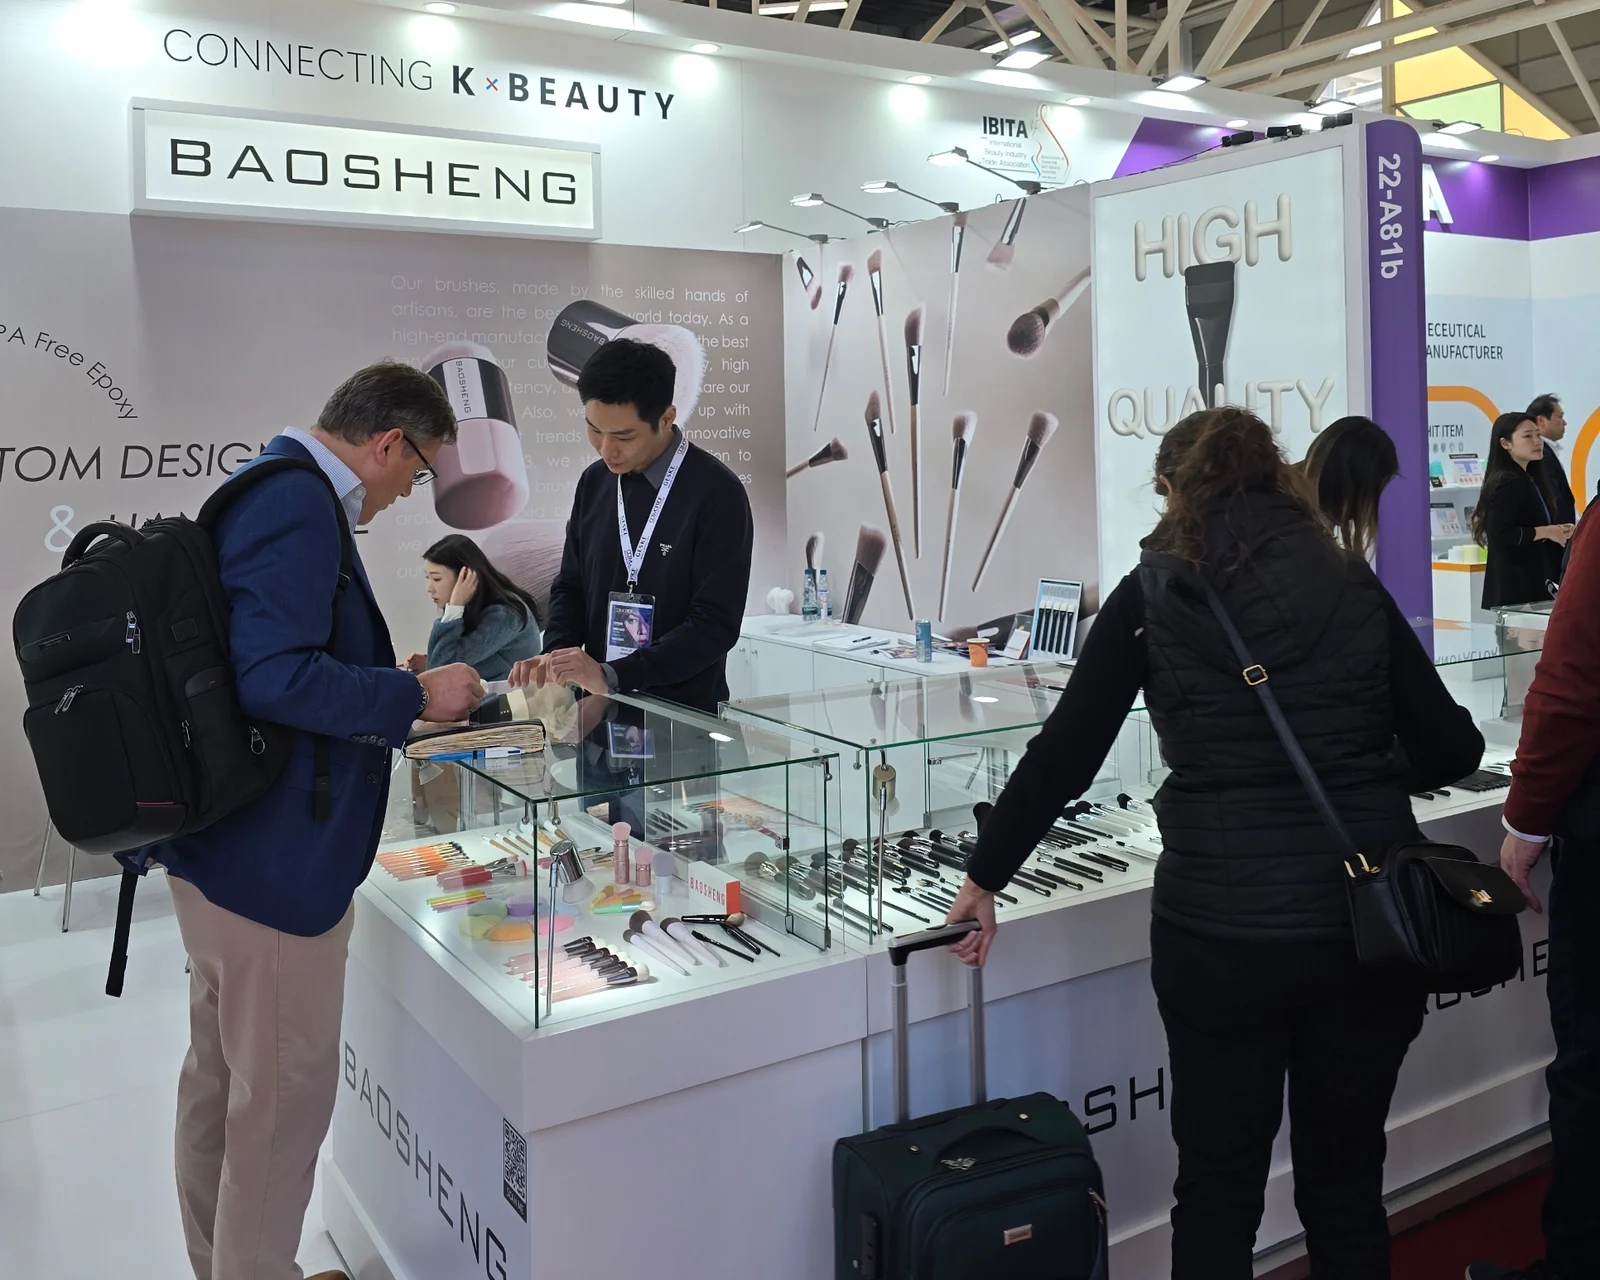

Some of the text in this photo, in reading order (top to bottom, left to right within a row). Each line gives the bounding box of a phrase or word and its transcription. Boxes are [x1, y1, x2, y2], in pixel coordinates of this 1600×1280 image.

[163, 28, 433, 92] CONNECTING
[983, 116, 1029, 138] IBITA
[985, 149, 1027, 159] Beauty Industry
[990, 141, 1021, 149] International
[170, 138, 577, 206] BAOSHENG
[1000, 160, 1030, 168] Association
[1377, 153, 1404, 280] 22-A81b
[1134, 193, 1292, 282] HIGH
[391, 275, 749, 304] Our brushes, made by the skilled hands of
[391, 302, 458, 318] artisans,
[466, 306, 494, 318] are
[501, 304, 527, 319] the
[534, 305, 559, 320] bes
[668, 311, 712, 327] today.
[718, 312, 734, 326] As
[739, 315, 749, 326] a
[392, 327, 749, 348] high-end manufact the best
[560, 318, 606, 346] BAOSHENG
[1427, 322, 1487, 339] ECEUTICAL
[1426, 344, 1504, 361] ANUFACTURER
[34, 331, 84, 366] Free
[86, 361, 139, 419] Epoxy
[722, 358, 750, 374] high
[455, 360, 472, 414] BAOSHENG
[703, 383, 725, 394] are
[729, 383, 751, 394] our
[521, 405, 557, 420] Also,
[699, 406, 716, 419] up
[724, 403, 751, 417] with
[536, 427, 582, 443] trends
[683, 425, 752, 440] innovative
[1442, 424, 1464, 438] ITEM
[120, 442, 267, 479] DESIG
[547, 455, 571, 468] we
[737, 448, 752, 462] to
[396, 513, 435, 526] arou
[395, 539, 423, 552] we
[690, 877, 725, 905] BAOSHENG
[345, 1041, 507, 1280] BAOSHENG
